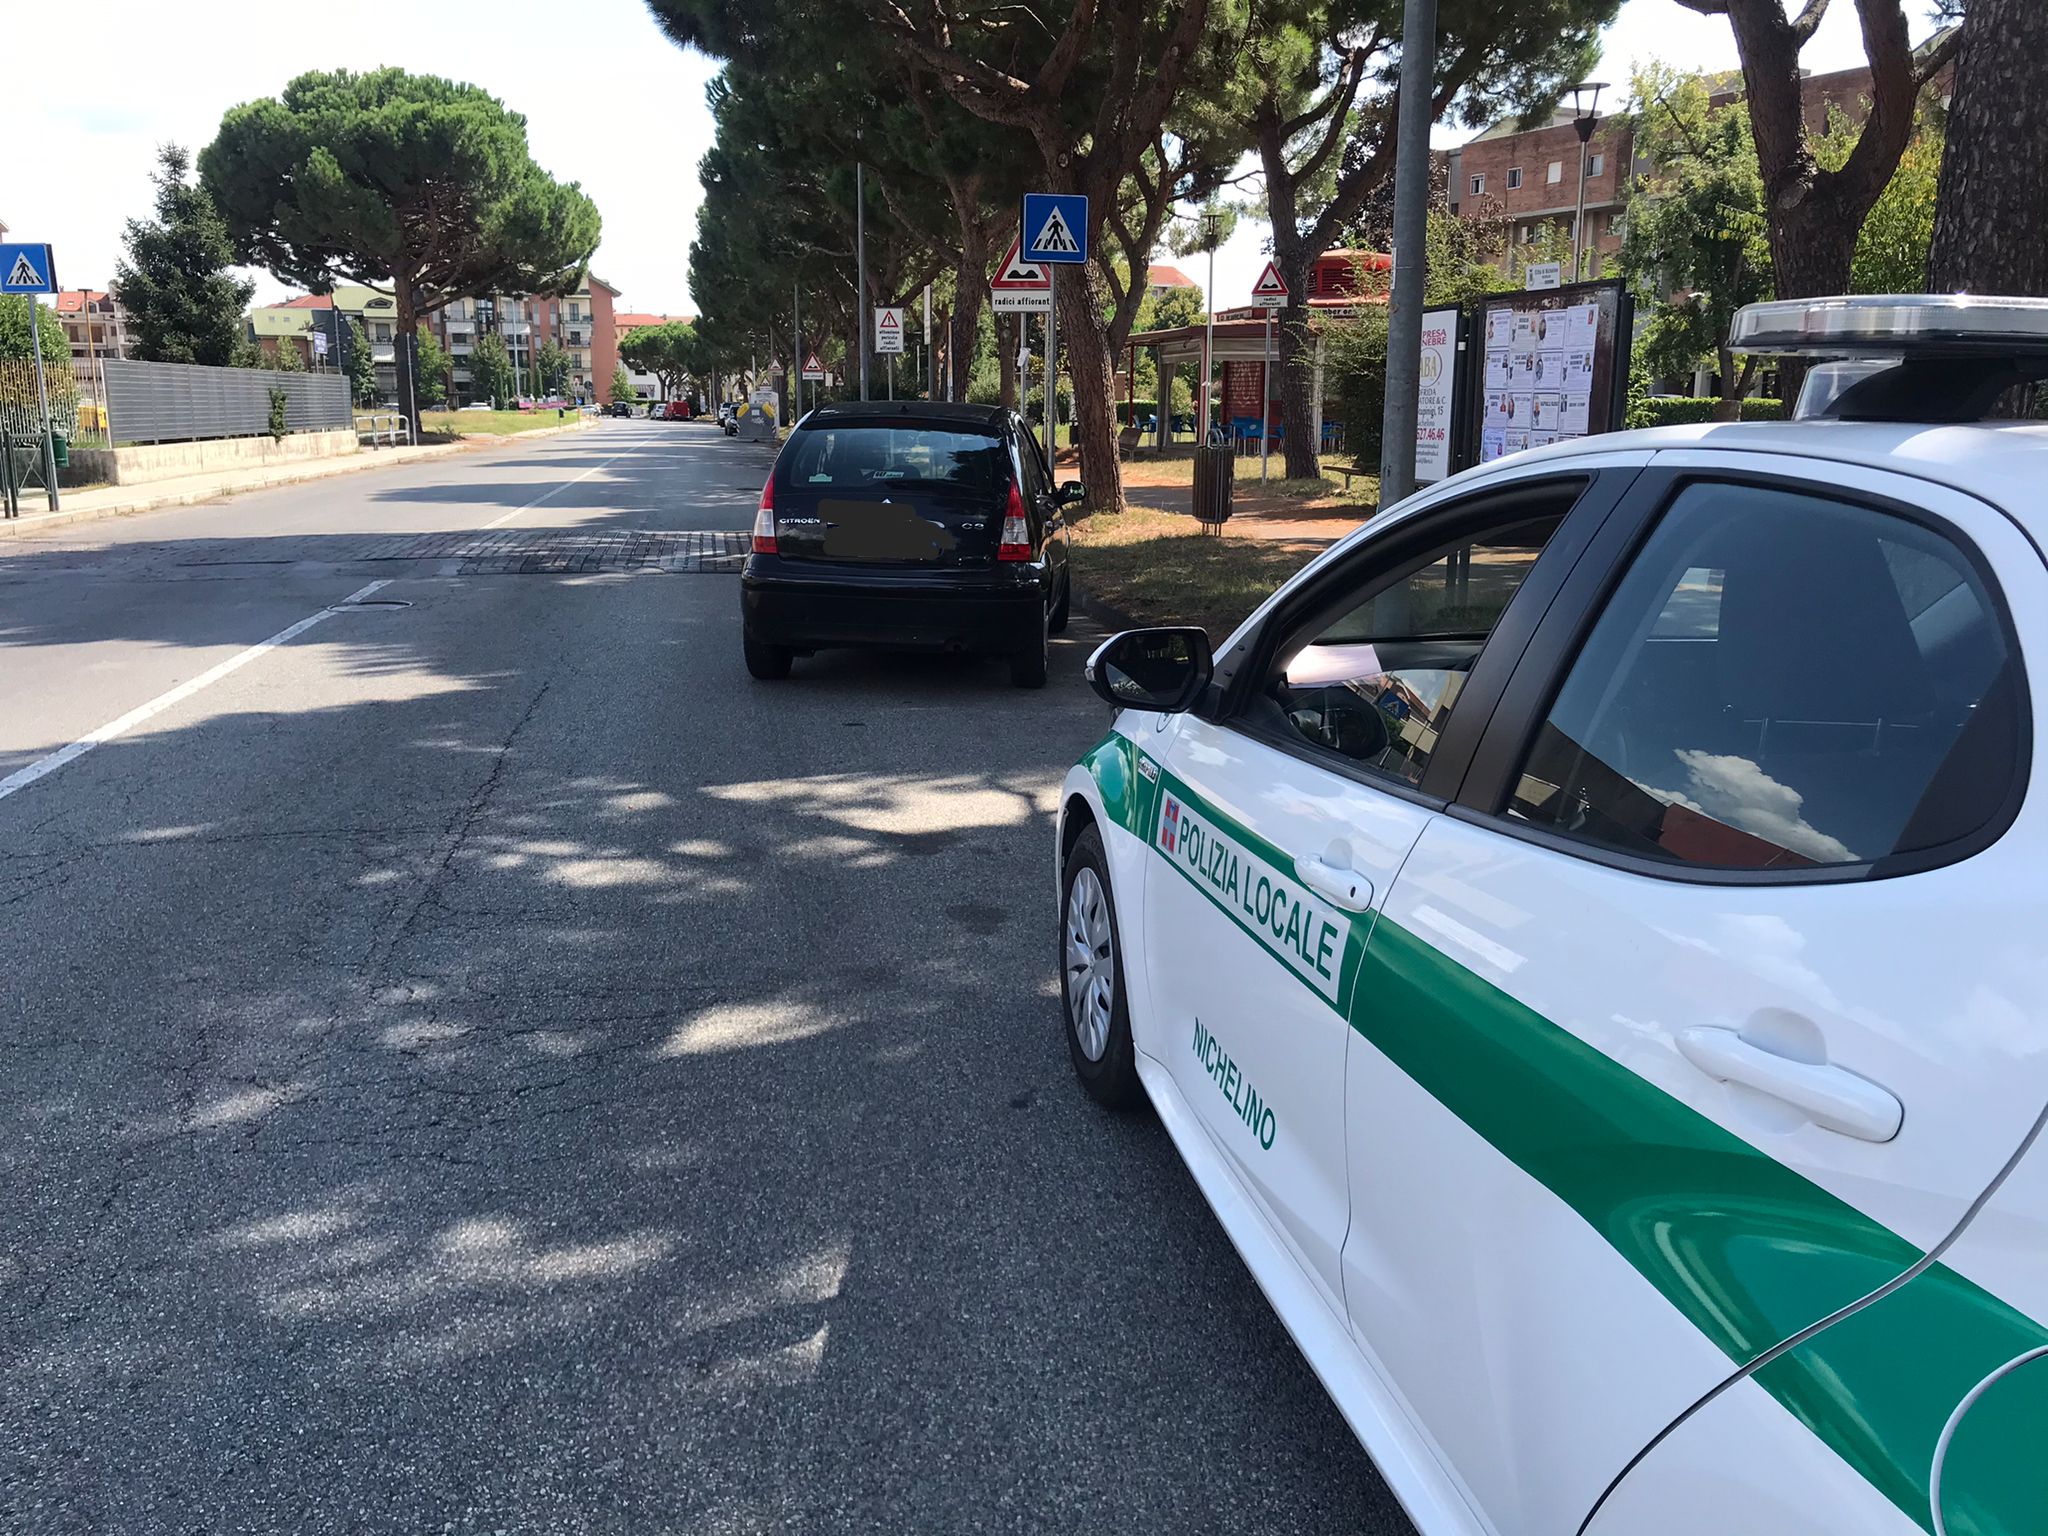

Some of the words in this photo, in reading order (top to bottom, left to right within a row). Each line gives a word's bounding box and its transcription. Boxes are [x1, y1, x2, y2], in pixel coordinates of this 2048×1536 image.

[994, 297, 1015, 305] radici
[1017, 297, 1050, 305] affiorant
[1422, 329, 1447, 339] PRESA
[1421, 336, 1447, 346] NEBRE
[1418, 388, 1437, 396] FRIDA
[1418, 396, 1436, 405] ATORE
[1178, 815, 1239, 904] POLIZIA
[1243, 865, 1339, 982] LOCALE
[1192, 1016, 1276, 1151] NICHELINO
